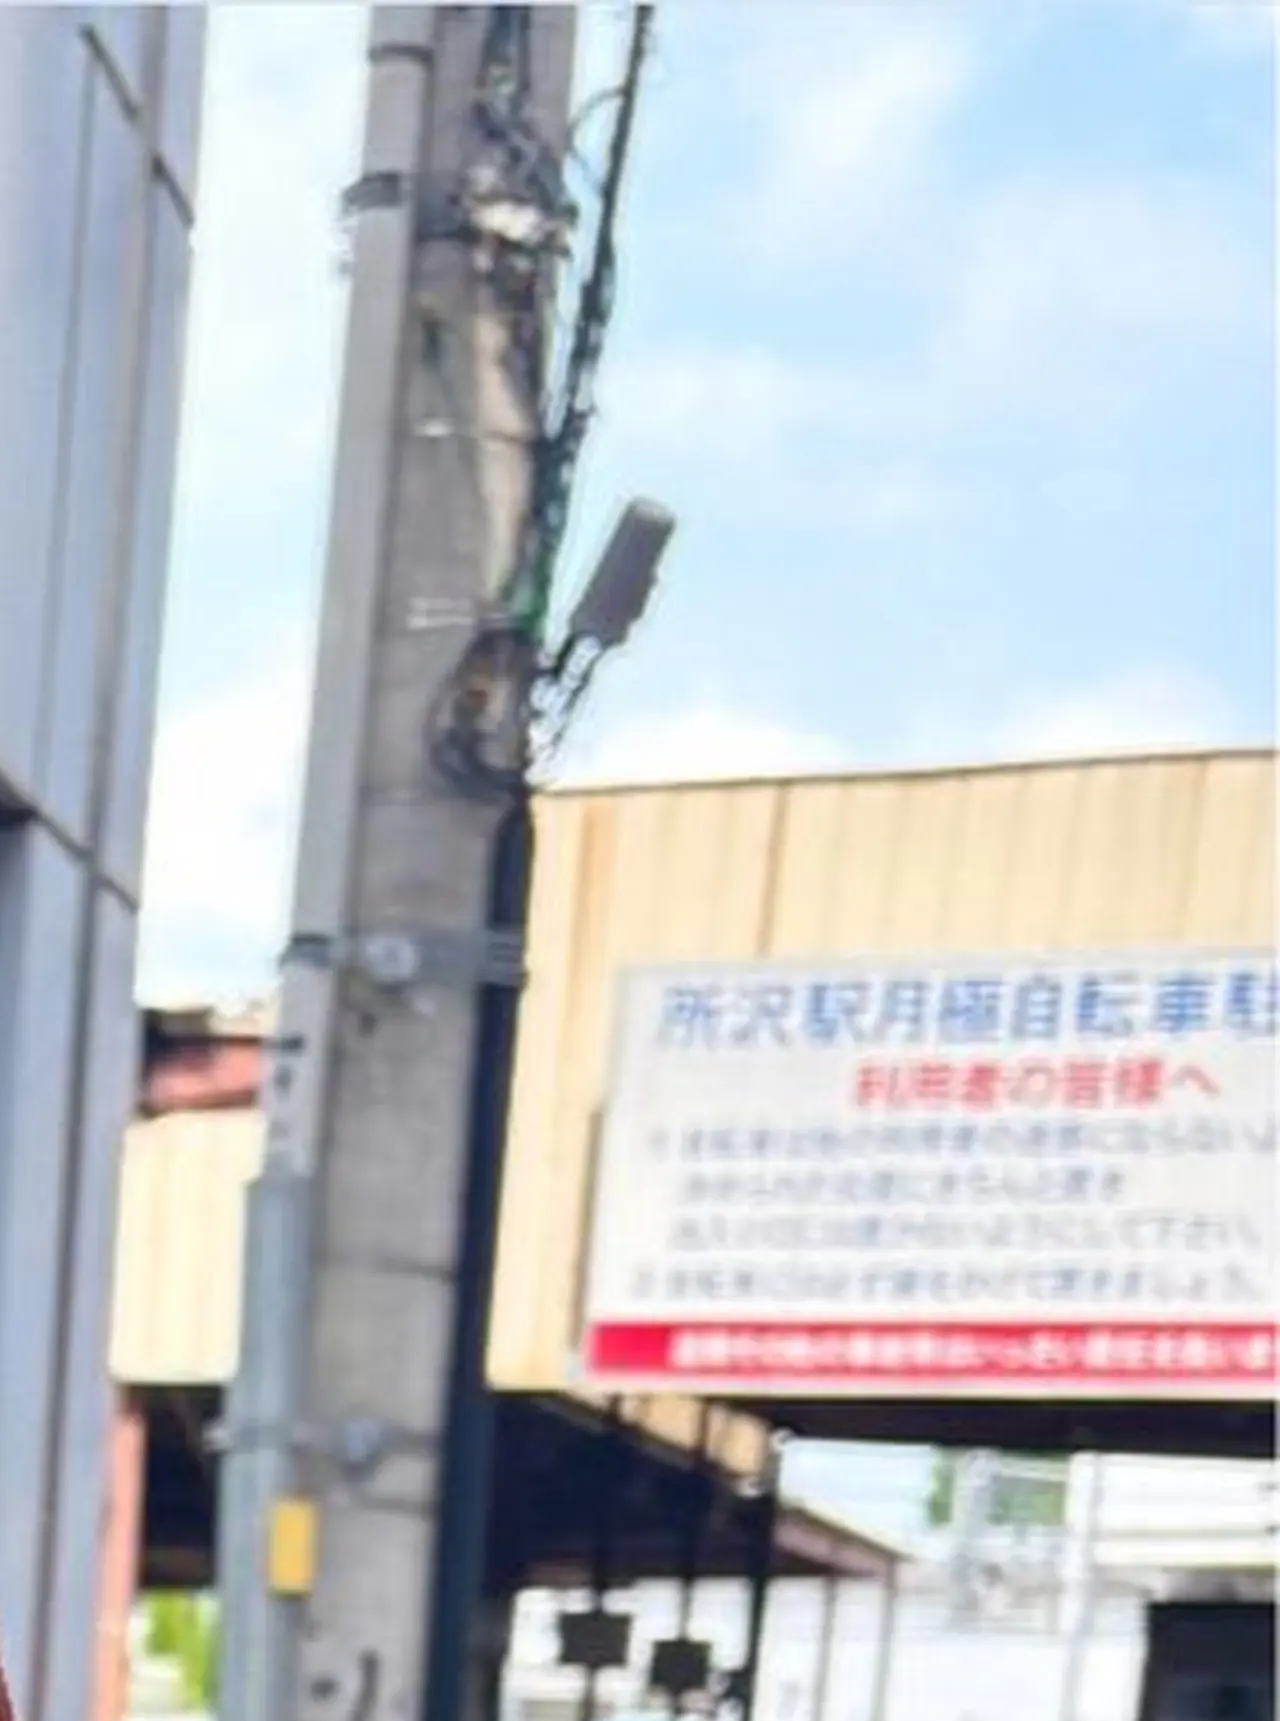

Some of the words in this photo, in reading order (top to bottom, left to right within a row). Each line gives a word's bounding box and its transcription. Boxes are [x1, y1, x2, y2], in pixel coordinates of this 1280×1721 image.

[854, 1056, 1221, 1108] 利用者の皆様へ
